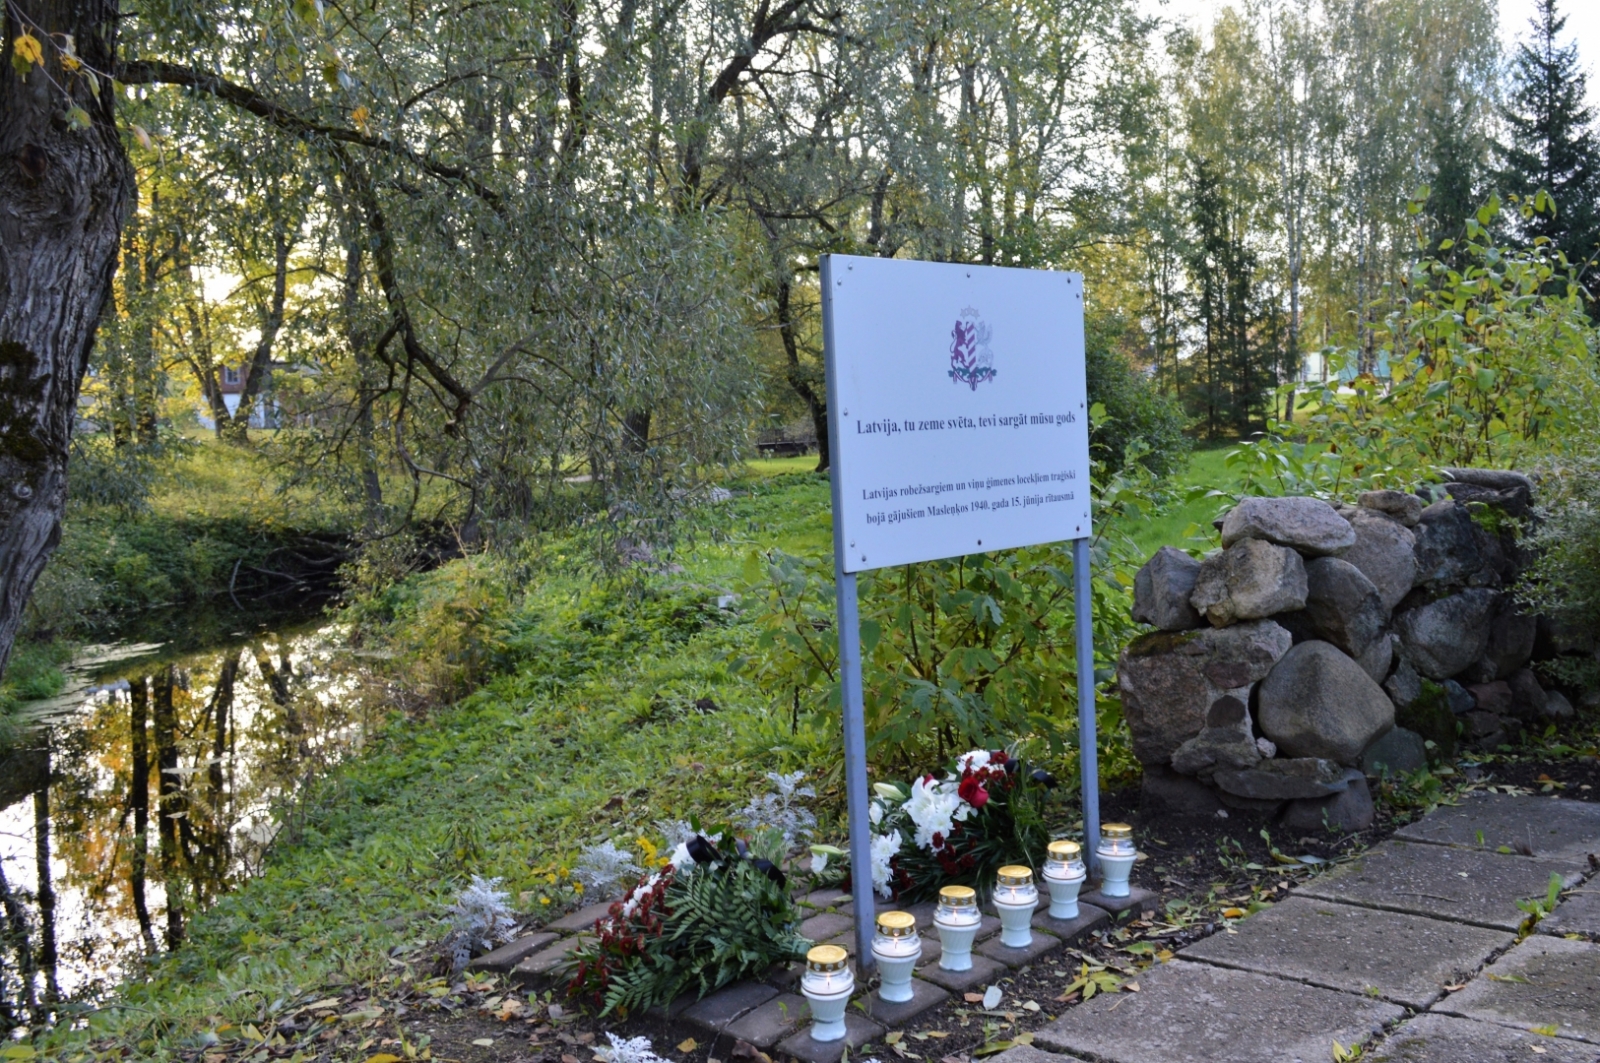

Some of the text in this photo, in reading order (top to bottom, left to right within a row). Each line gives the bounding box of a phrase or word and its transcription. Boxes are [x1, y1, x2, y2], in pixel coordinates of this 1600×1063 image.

[857, 411, 1076, 436] Latvija, tu zeme svēta, tevi sargāt mūsu gods
[862, 469, 1076, 501] Latvijas robežsargiem un viņu ģimenes locekļiem traģiski
[866, 491, 1074, 526] bojā gājušiem Masleņķos 1940. gada 15. jūnija rītausmā
